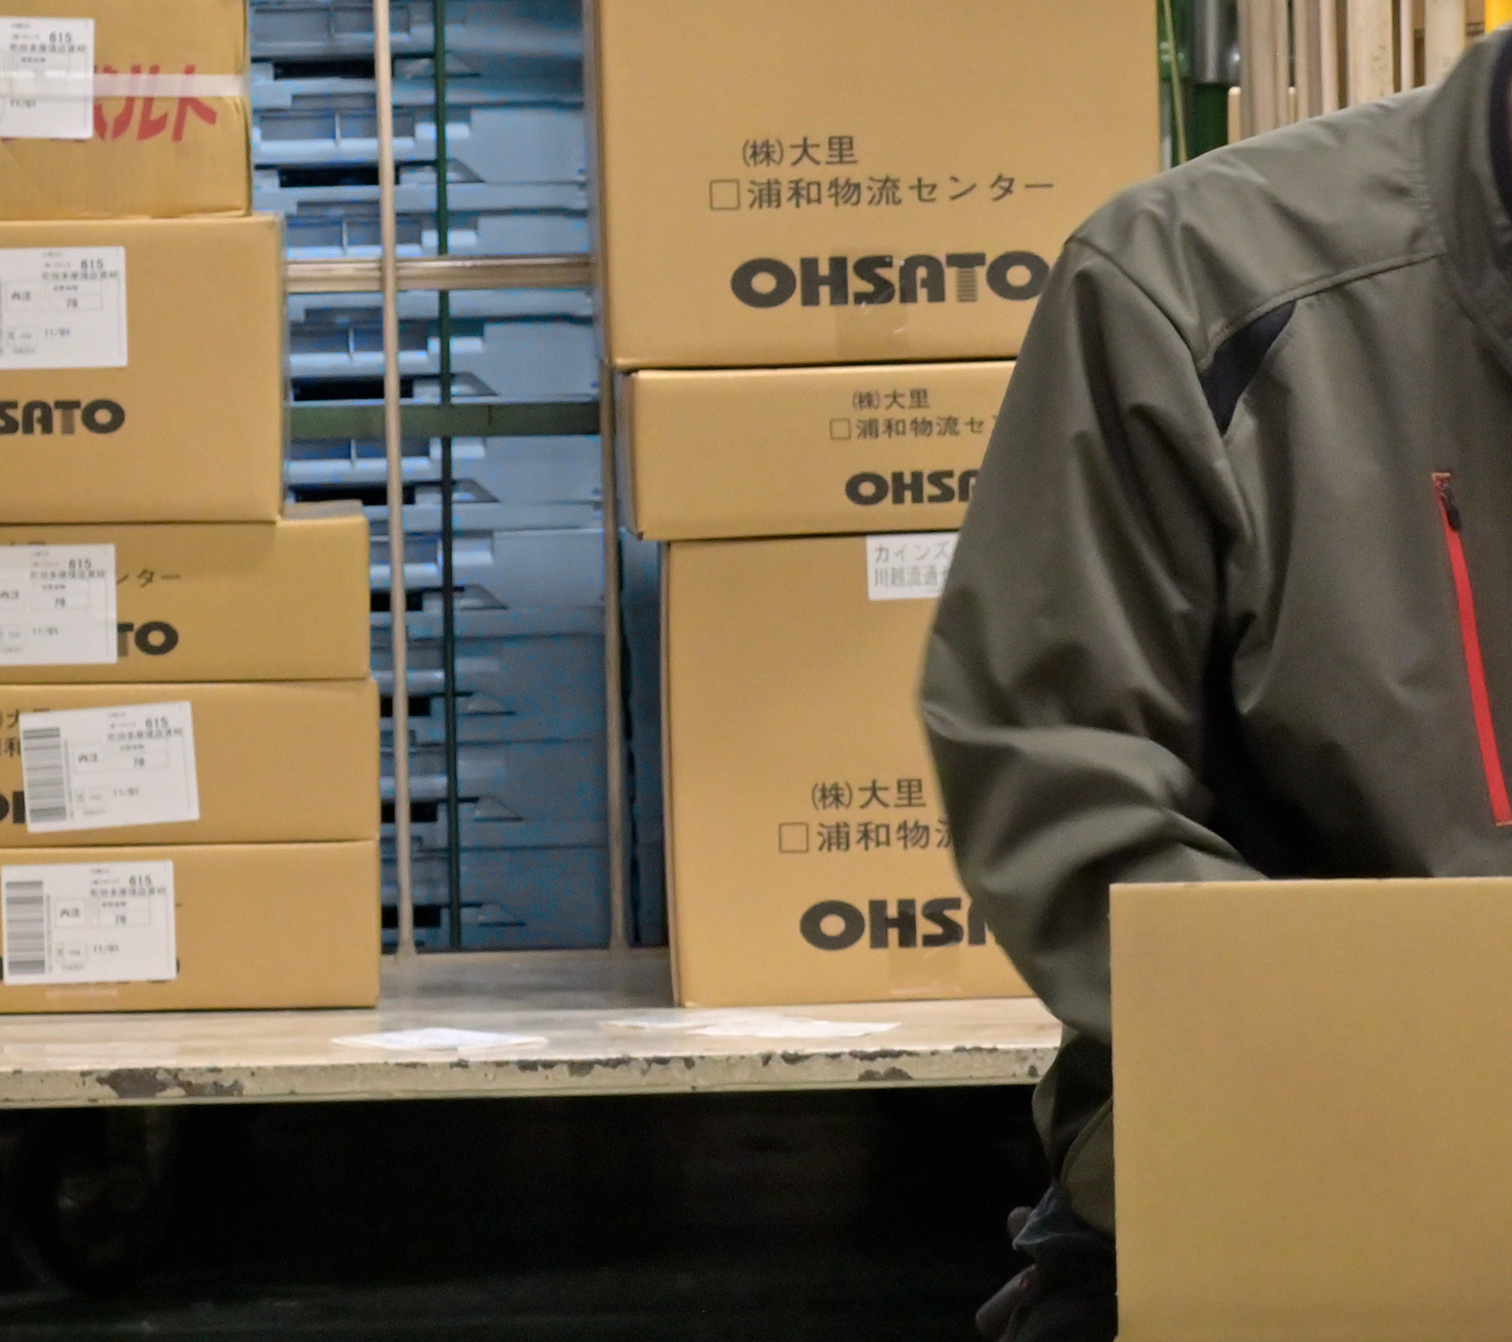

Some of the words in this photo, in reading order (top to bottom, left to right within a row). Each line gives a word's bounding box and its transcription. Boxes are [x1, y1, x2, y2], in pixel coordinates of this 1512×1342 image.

[742, 136, 859, 167] (株)大里
[747, 172, 1055, 211] 浦和物流センター
[731, 250, 1051, 309] OHSATO
[852, 389, 930, 411] (株)大里
[810, 779, 927, 810] (株)大里
